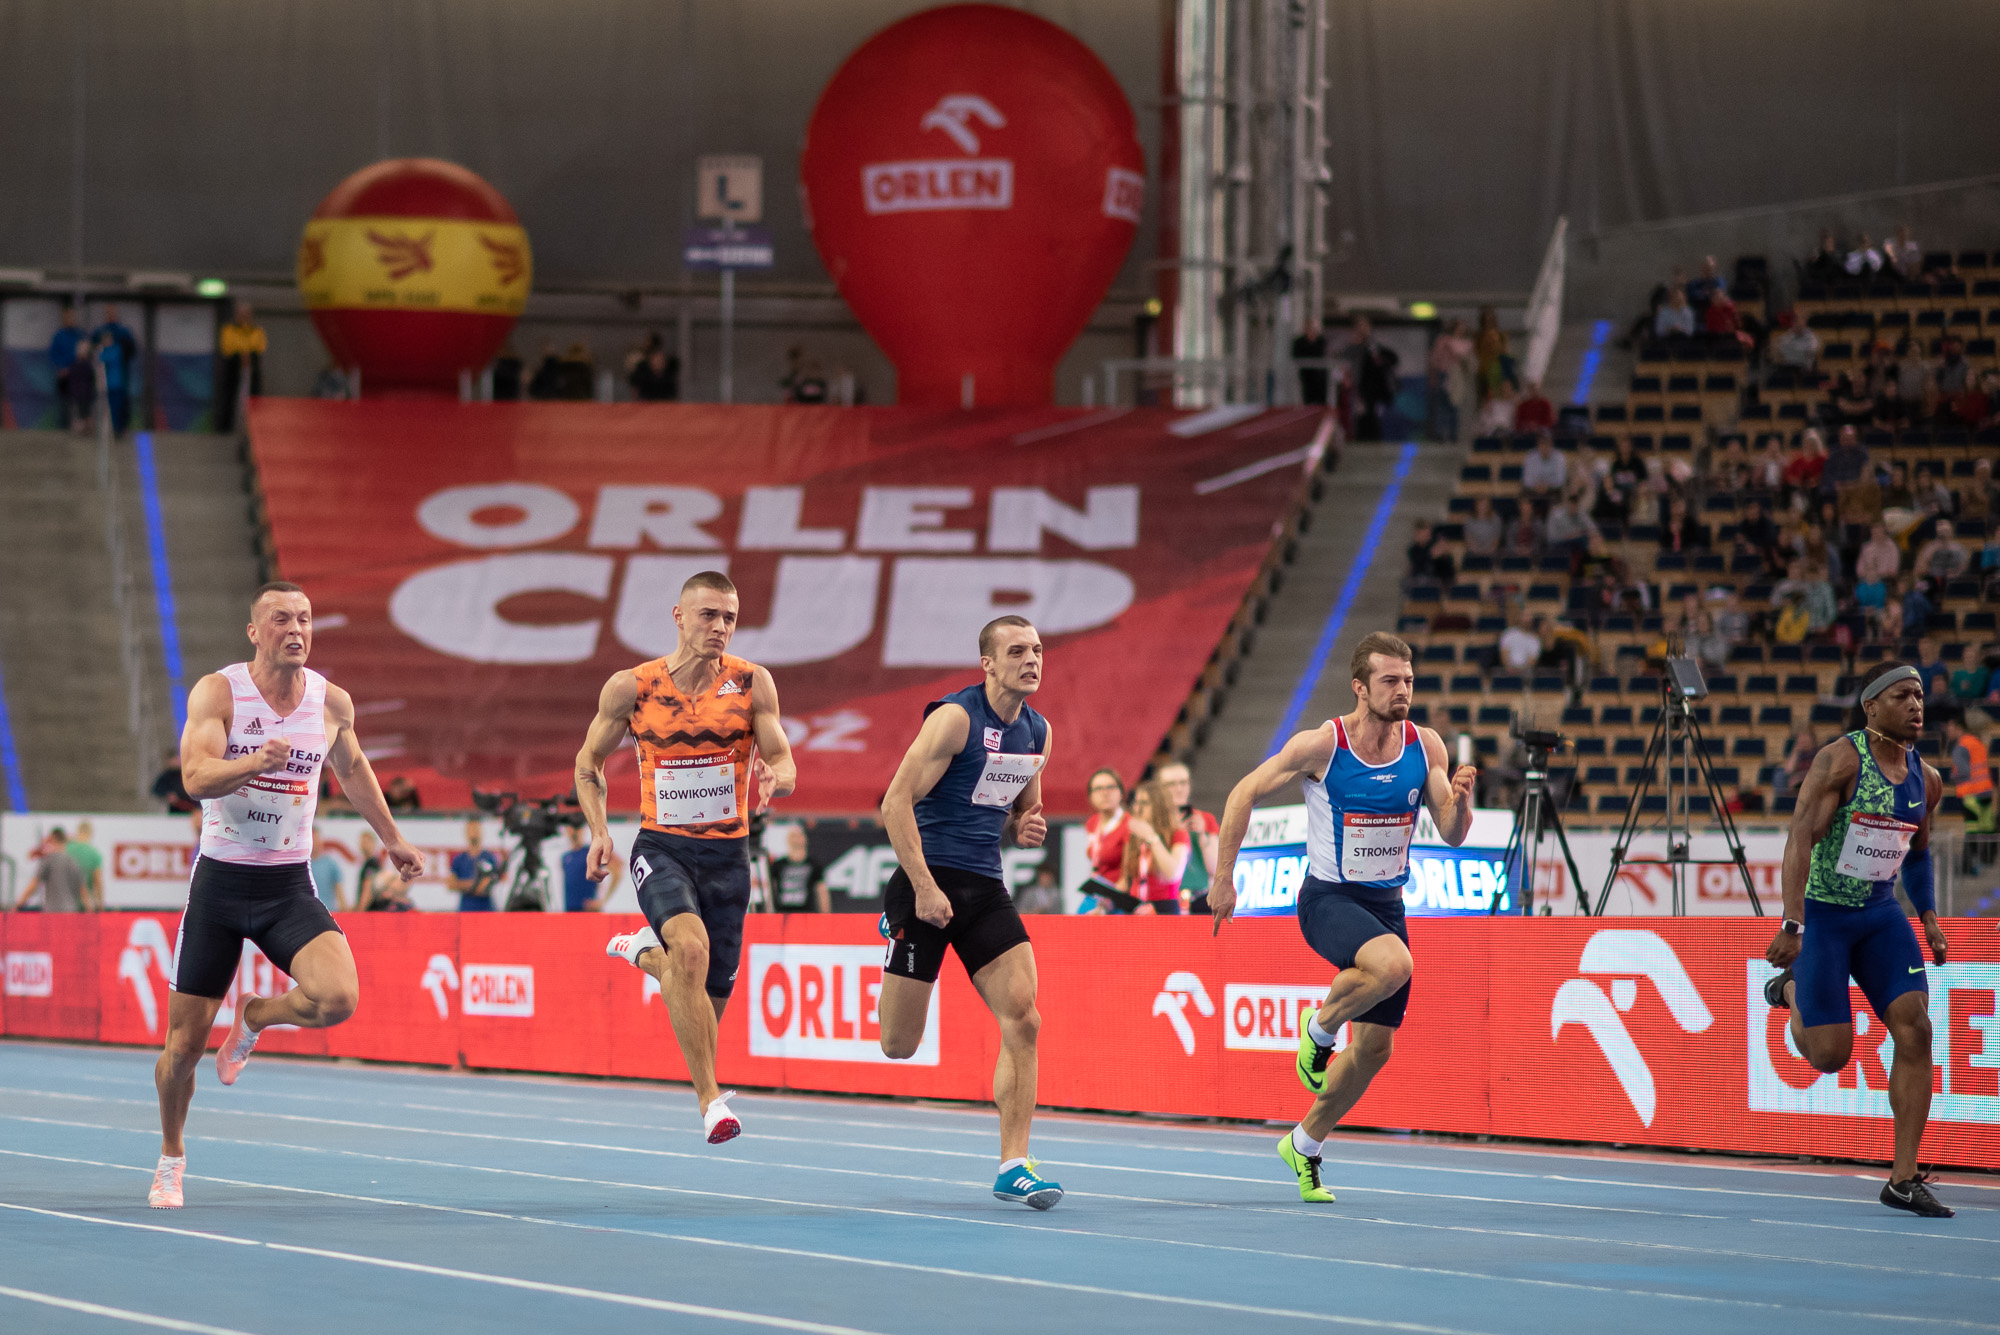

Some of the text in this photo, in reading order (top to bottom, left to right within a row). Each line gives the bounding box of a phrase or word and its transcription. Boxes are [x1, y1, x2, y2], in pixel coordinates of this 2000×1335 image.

[716, 174, 744, 210] L
[872, 169, 1001, 202] ORLEN
[415, 482, 1139, 551] ORLEN
[389, 552, 1135, 668] CUP
[717, 687, 742, 696] adidas
[243, 728, 265, 736] adidas
[229, 744, 322, 763] GATHEAD
[681, 758, 694, 766] CUP
[694, 756, 713, 765] ŁÓDŹ
[713, 755, 728, 763] 2020
[985, 772, 1033, 784] OLSZEWSK
[659, 784, 733, 800] SŁOWIKOWSKI
[247, 809, 283, 825] KILTY
[1858, 817, 1879, 826] ORLEN
[121, 849, 192, 874] ORL
[1855, 844, 1903, 859] RODGERS
[634, 861, 645, 884] 5
[1001, 848, 1046, 900] F
[1402, 858, 1511, 911] ORLEN
[1702, 867, 1782, 894] ORL
[471, 974, 527, 1005] ORLEN
[761, 962, 882, 1040] ORLE
